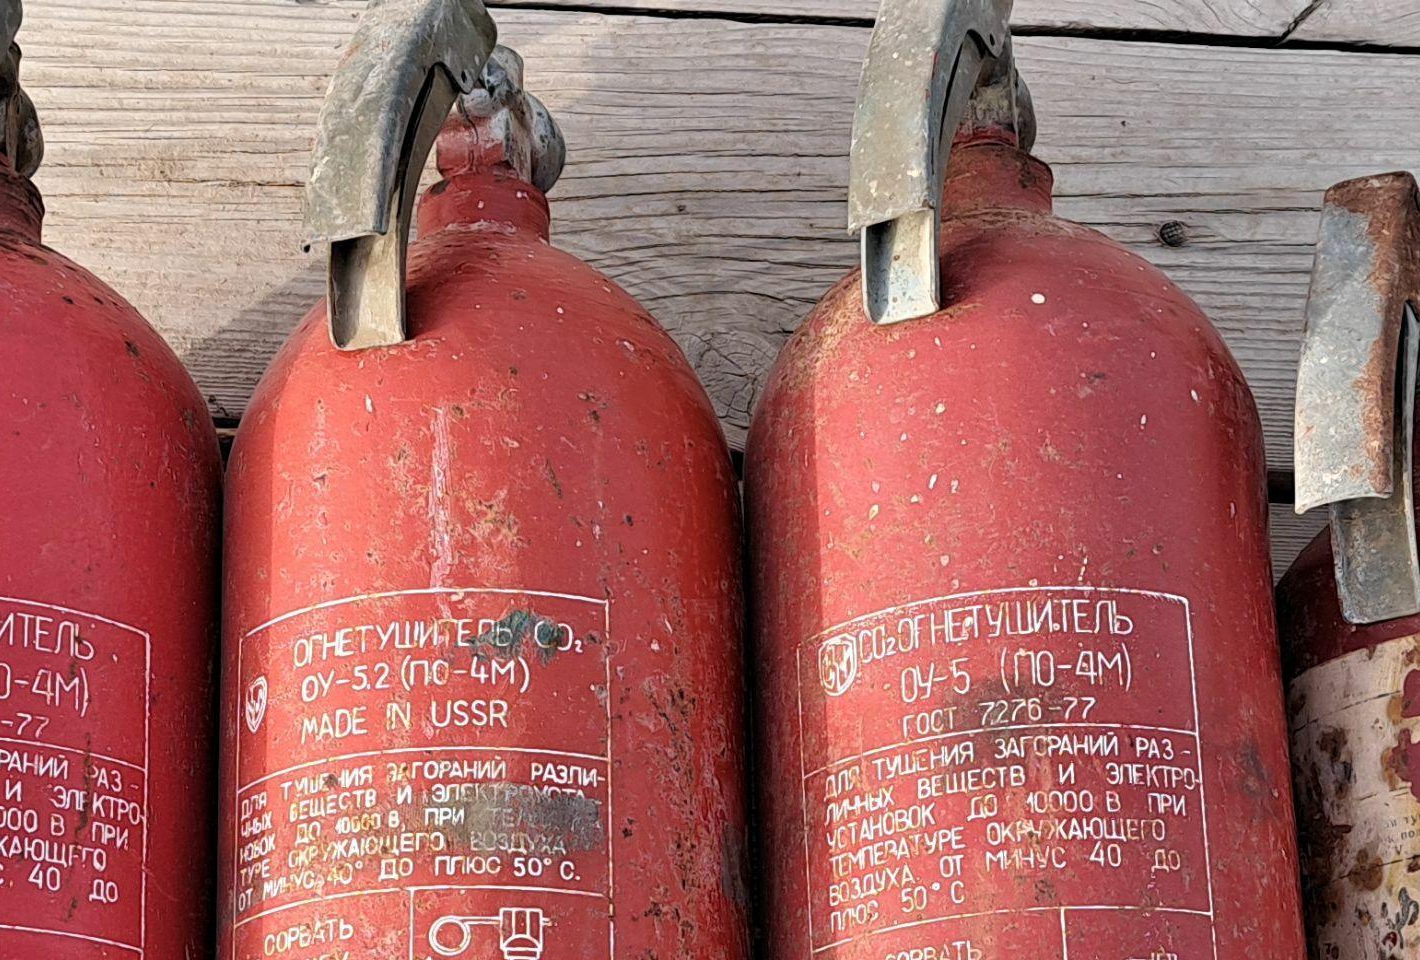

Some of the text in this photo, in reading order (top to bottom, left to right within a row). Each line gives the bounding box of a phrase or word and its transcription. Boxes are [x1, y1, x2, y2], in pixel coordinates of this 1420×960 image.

[301, 700, 508, 744] MADE IN USSR
[902, 705, 957, 738] ГОСТ
[5, 779, 21, 800] И
[917, 765, 1025, 798] ВЕЩЕСТВ
[1059, 765, 1075, 785] И
[425, 808, 465, 826] ПРИ
[968, 795, 997, 821] ДО
[1148, 793, 1186, 816] ПРИ
[378, 858, 414, 882] ДО
[940, 855, 963, 876] ОТ
[1090, 844, 1121, 867] 40
[1152, 852, 1181, 873] ДО
[29, 865, 61, 891] 40
[89, 878, 119, 903] ДО
